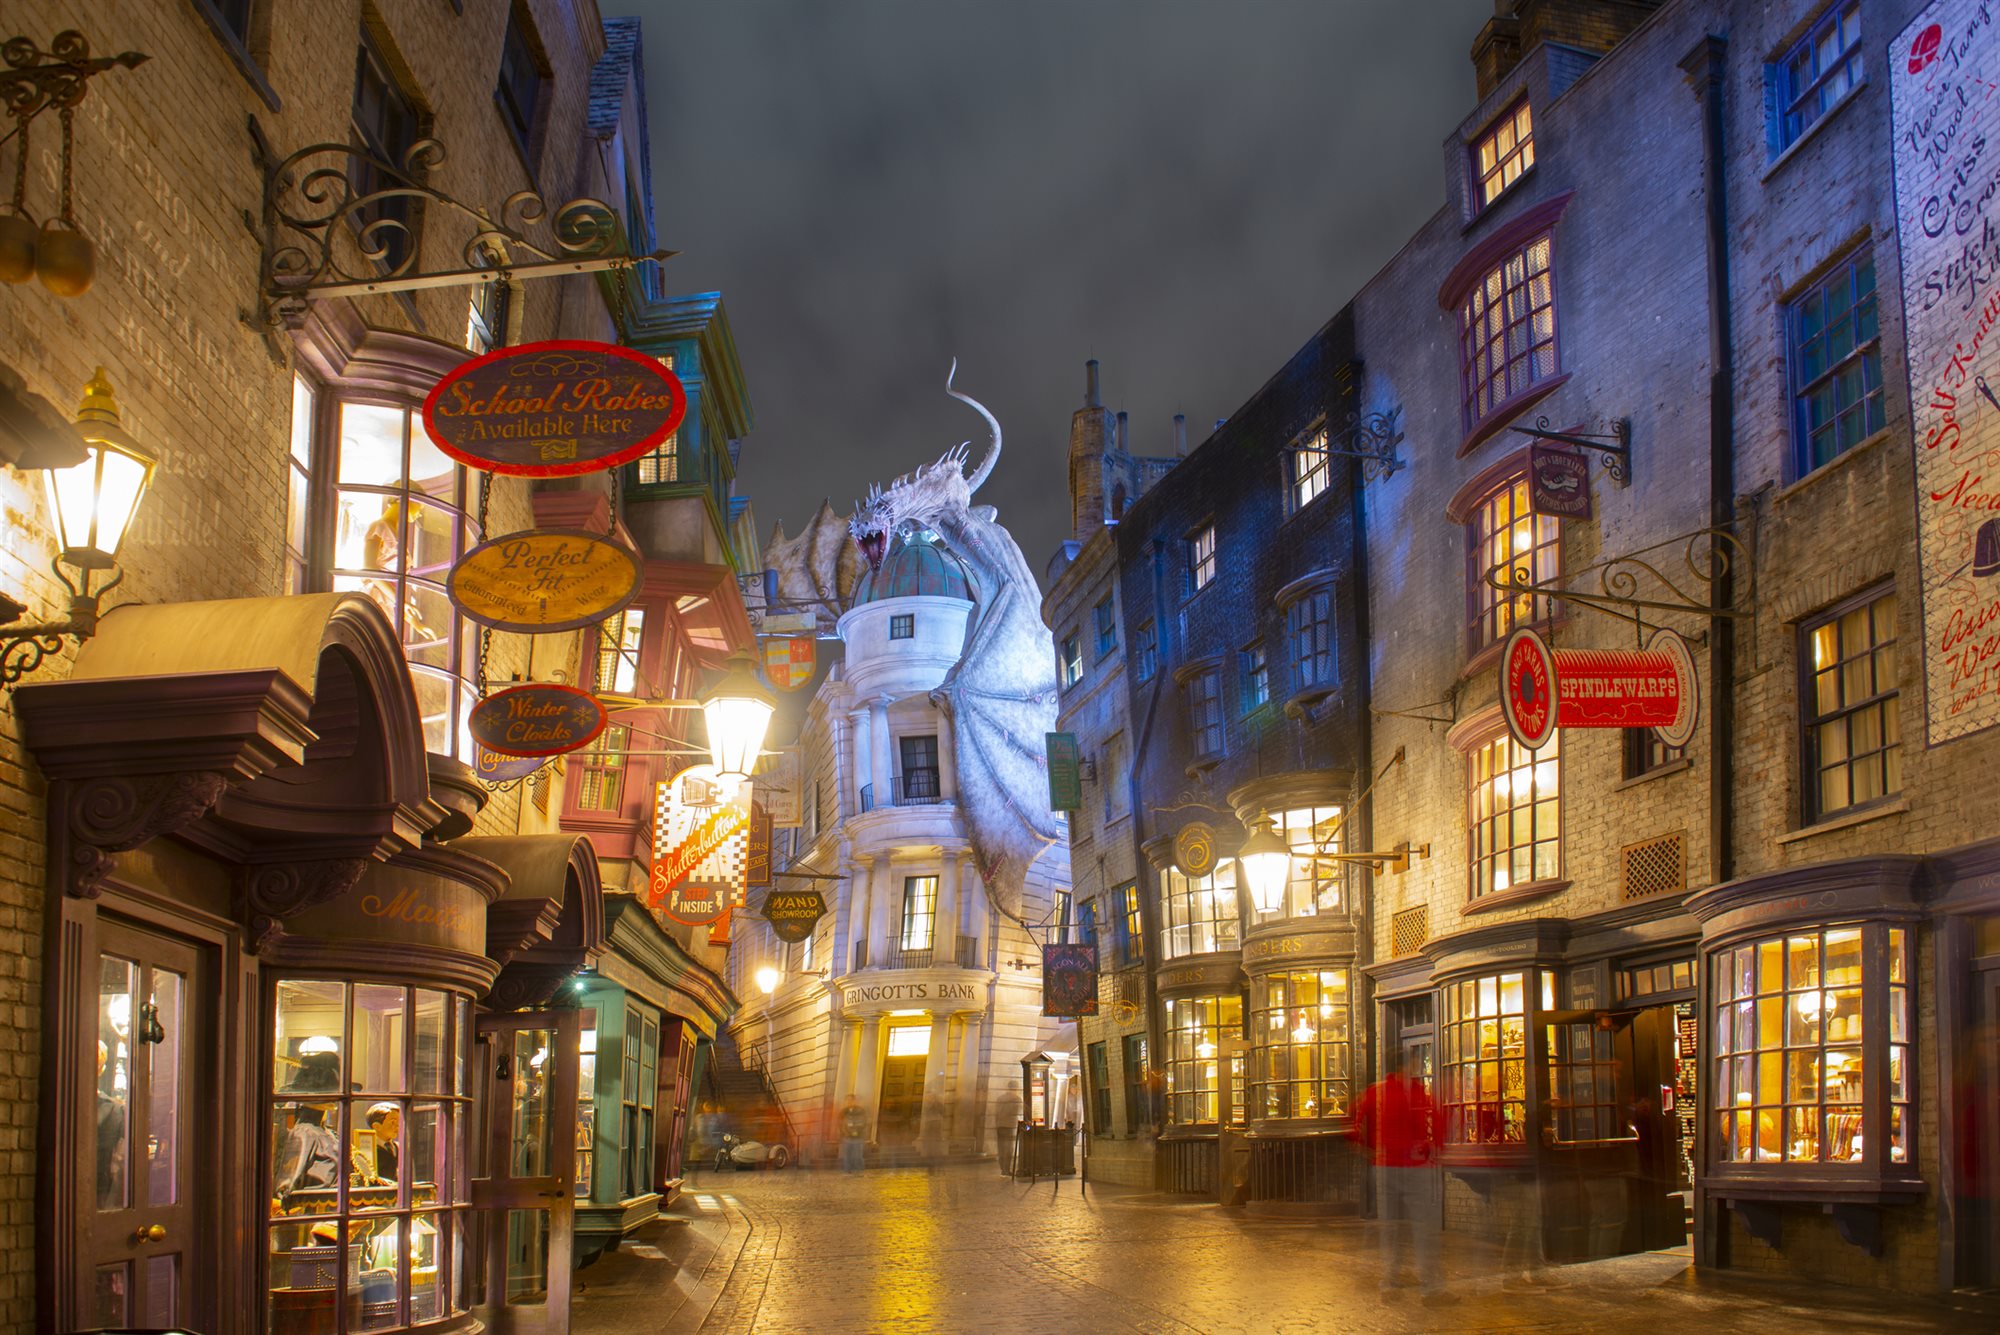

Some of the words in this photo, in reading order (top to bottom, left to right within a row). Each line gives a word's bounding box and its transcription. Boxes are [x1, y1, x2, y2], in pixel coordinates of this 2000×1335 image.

[1904, 0, 1991, 152] Never-Tang
[1923, 86, 1968, 170] Wool
[1922, 134, 1986, 238] Criss
[1923, 216, 1996, 311] Stitch
[439, 380, 565, 417] School
[562, 378, 671, 414] Robes
[470, 416, 574, 441] Available
[582, 414, 633, 435] Here
[502, 541, 595, 569] Perfect
[526, 567, 566, 592] Fit
[463, 579, 528, 617] Guaranteed
[576, 584, 609, 607] Wear
[1523, 643, 1545, 688] YARNS
[1560, 677, 1677, 698] SPINDLEWARPS
[507, 697, 569, 719] Winter
[1515, 701, 1545, 733] BUTTONS
[506, 721, 573, 743] Cloaks
[653, 804, 748, 894] Shutterbutton's
[680, 901, 714, 913] INSIDE
[685, 888, 710, 900] STEP
[771, 896, 818, 908] WAND
[771, 909, 818, 920] SHOWROOM
[846, 983, 928, 1005] GRINGOTTS
[938, 983, 975, 1000] BANK
